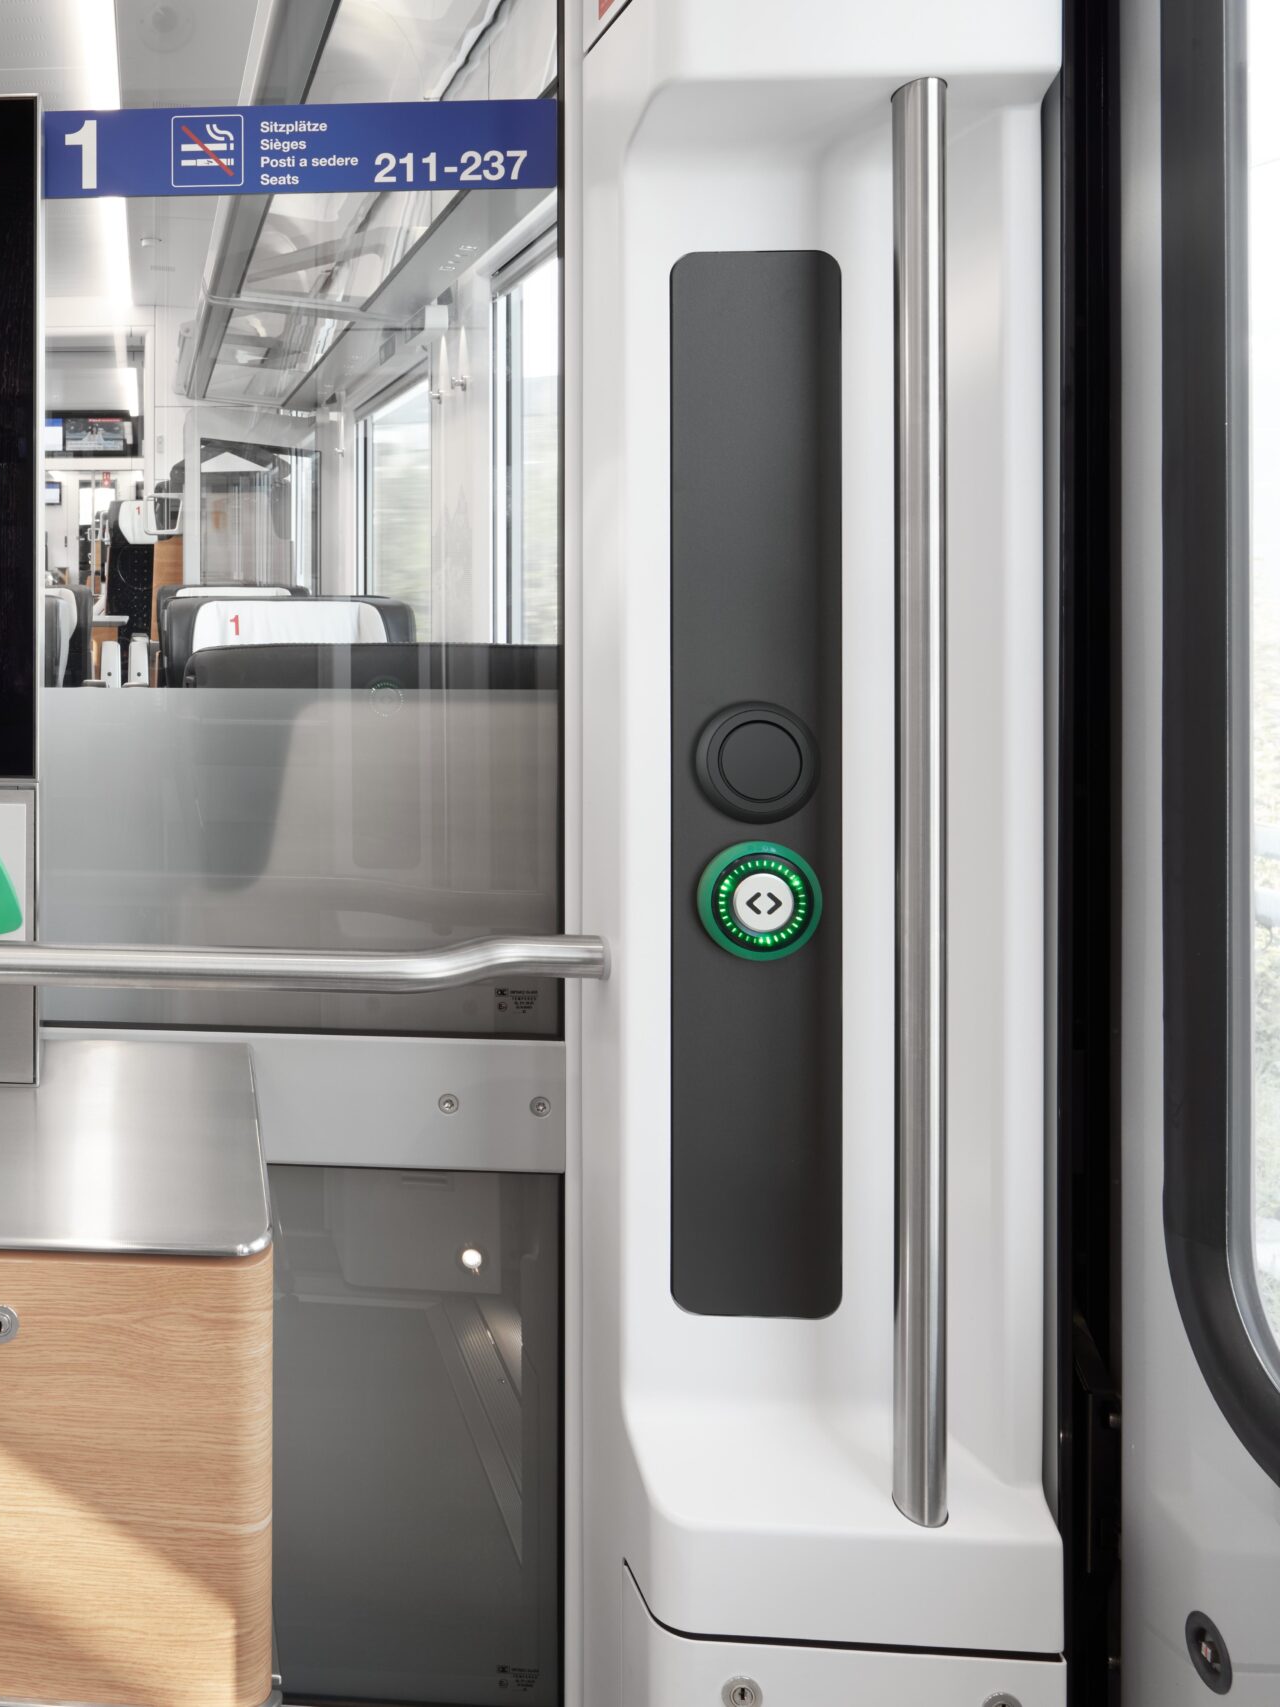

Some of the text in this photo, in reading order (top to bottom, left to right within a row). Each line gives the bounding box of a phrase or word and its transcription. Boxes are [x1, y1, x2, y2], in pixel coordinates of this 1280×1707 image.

[261, 121, 327, 134] Sitzplätze
[261, 139, 306, 152] Sièges
[65, 120, 97, 189] 1
[261, 155, 358, 167] Posti a sedere
[374, 151, 527, 182] 211-237
[261, 174, 299, 185] Seats
[229, 615, 240, 636] 1
